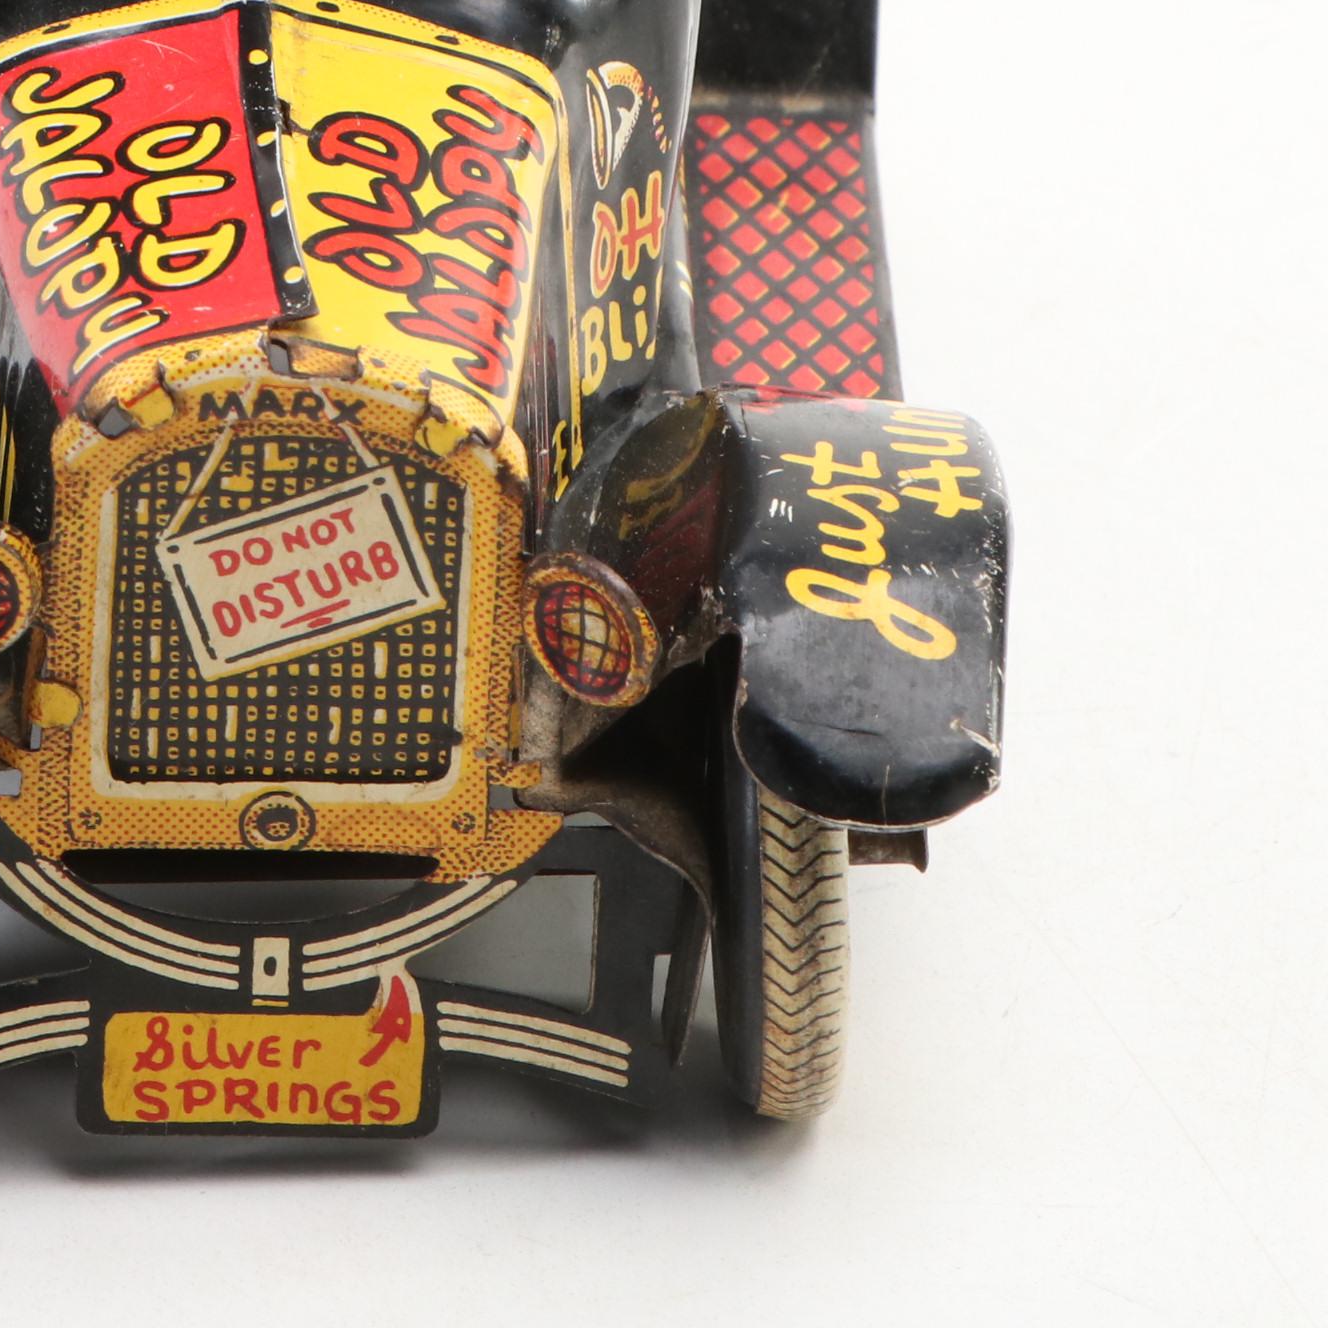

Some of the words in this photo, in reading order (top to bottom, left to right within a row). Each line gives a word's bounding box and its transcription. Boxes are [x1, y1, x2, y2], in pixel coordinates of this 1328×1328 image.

[118, 119, 242, 290] OLD
[304, 113, 429, 291] OLD
[590, 170, 664, 299] OH
[199, 390, 368, 425] MARX
[208, 535, 273, 578] DO
[283, 507, 357, 554] NOT
[211, 540, 401, 638] DISTURB
